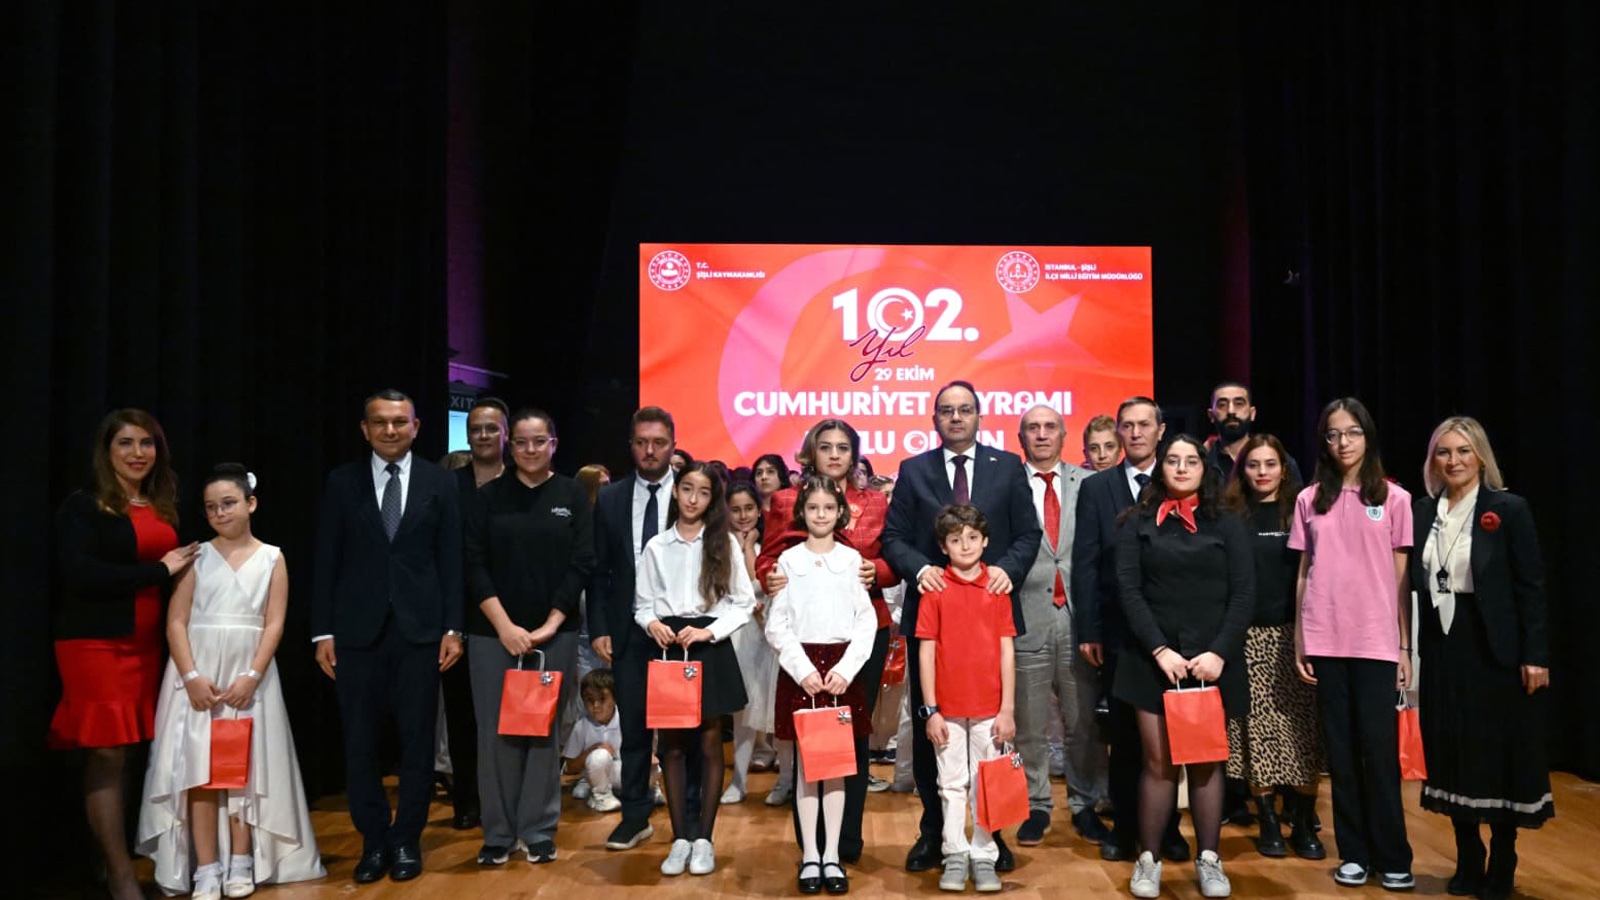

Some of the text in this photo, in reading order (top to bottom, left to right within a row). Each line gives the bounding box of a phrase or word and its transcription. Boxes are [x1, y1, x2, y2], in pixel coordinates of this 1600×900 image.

[832, 287, 979, 341] 102.
[874, 365, 935, 381] 29 EKİM
[451, 395, 474, 409] XIT
[734, 385, 1072, 417] CUMHURİYET YRAMI
